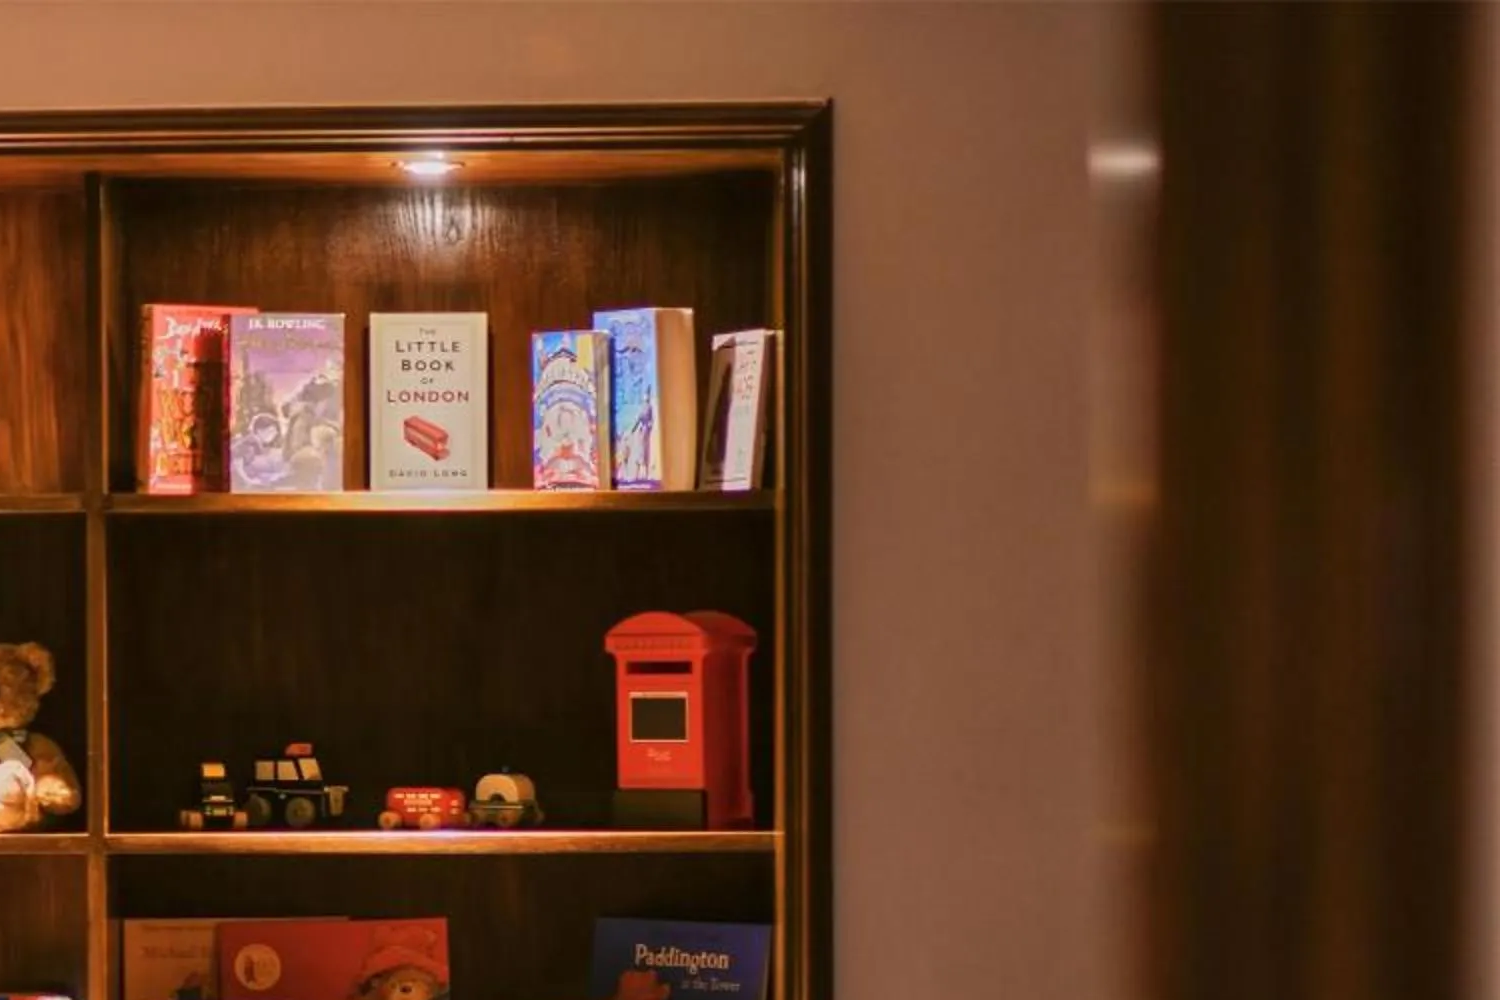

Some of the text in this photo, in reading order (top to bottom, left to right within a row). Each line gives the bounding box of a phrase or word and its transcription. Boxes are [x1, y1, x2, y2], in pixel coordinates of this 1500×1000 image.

[395, 340, 461, 353] LITTLE
[401, 359, 455, 372] BOOK
[387, 389, 469, 403] LONDON
[635, 943, 730, 975] Paddington
